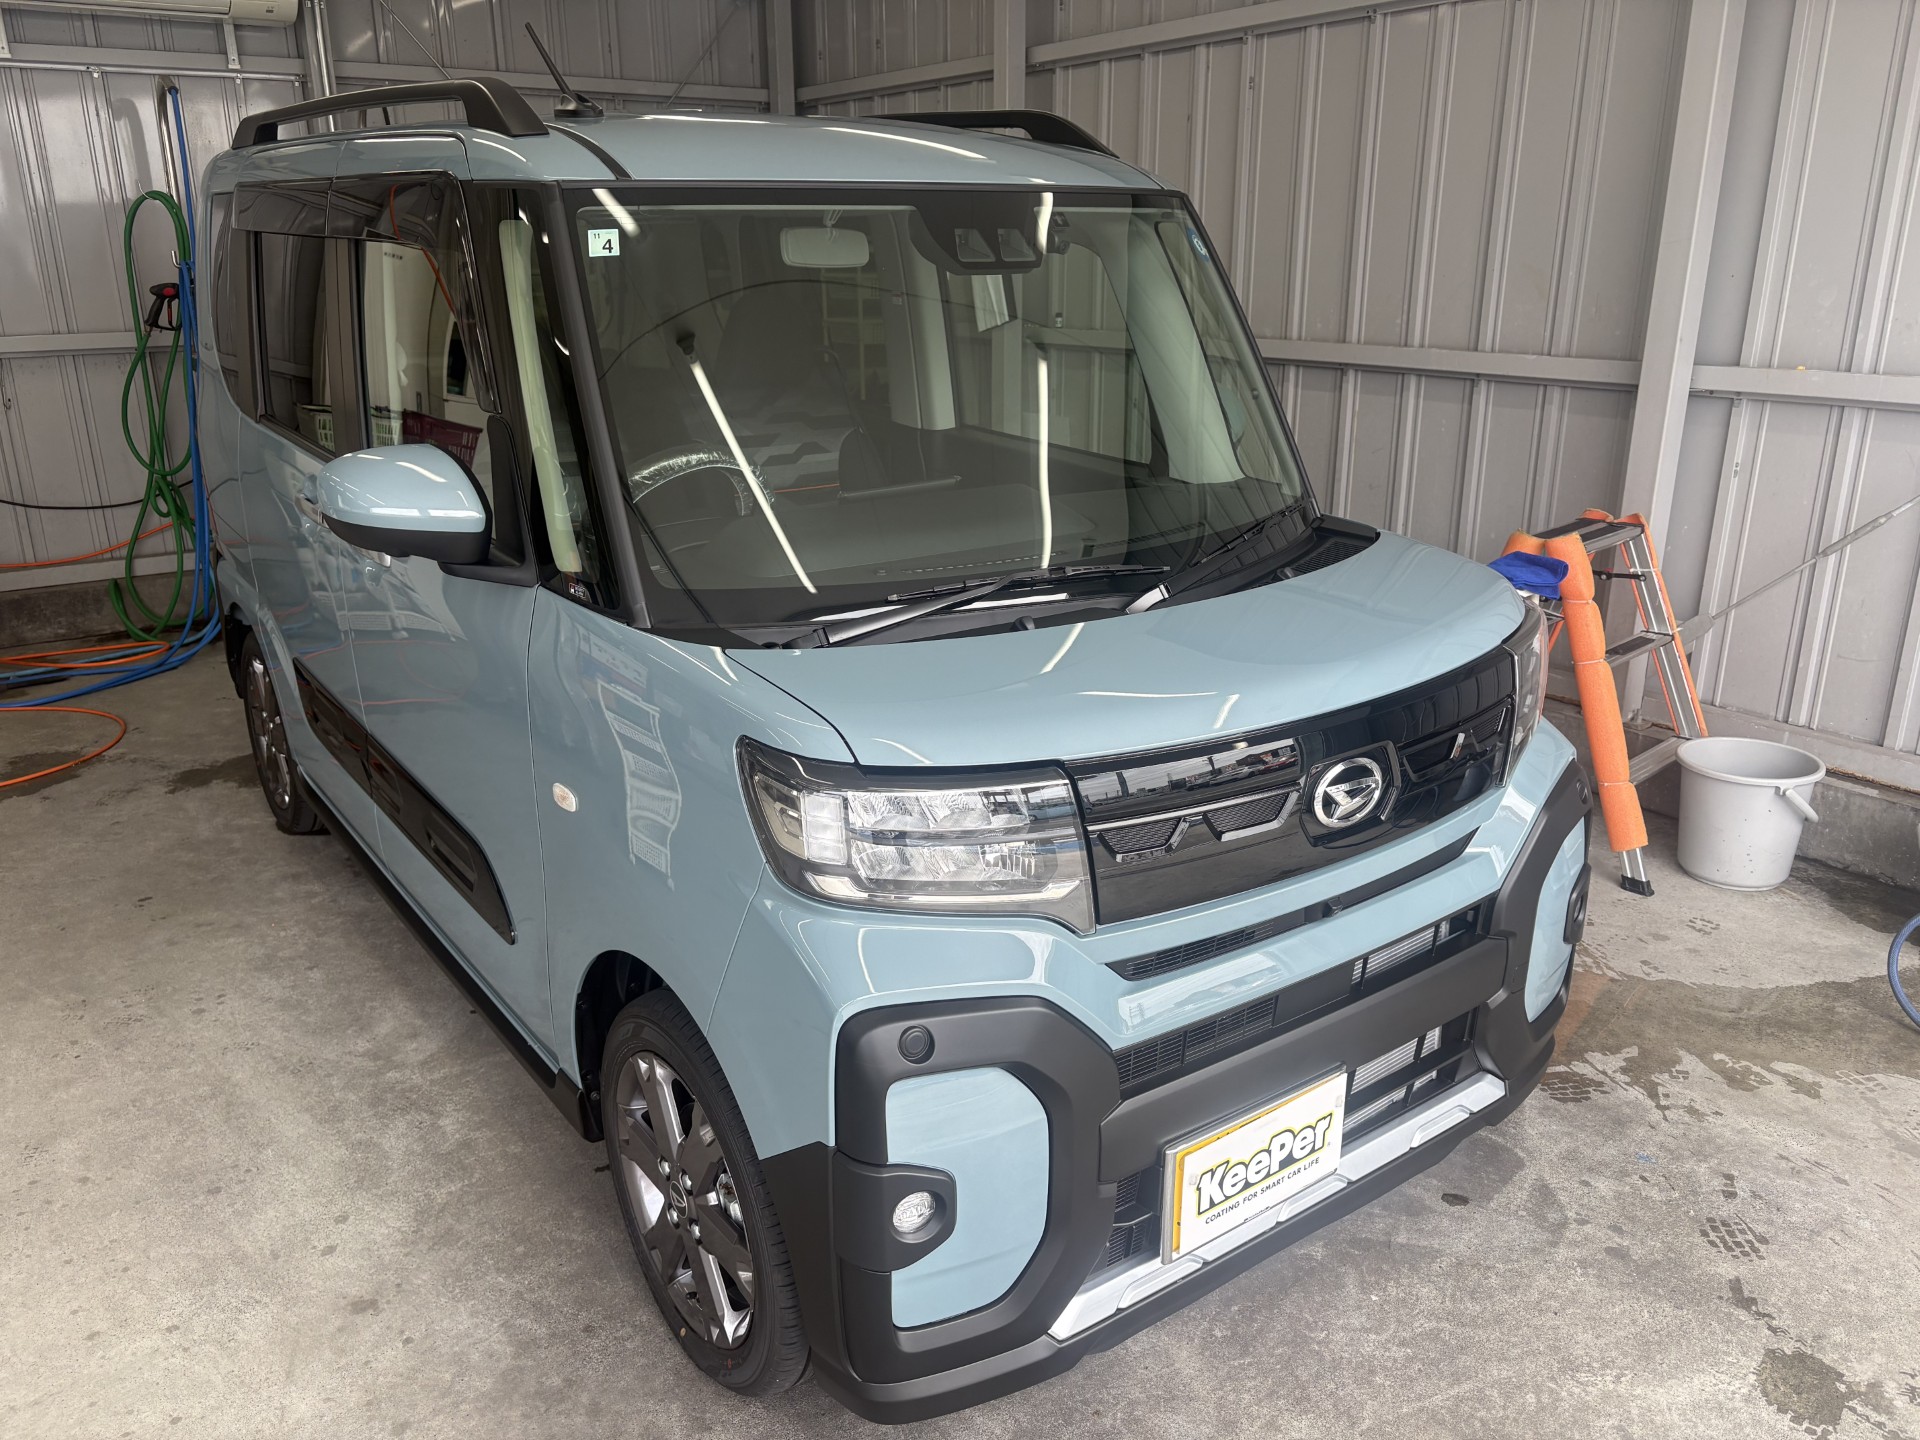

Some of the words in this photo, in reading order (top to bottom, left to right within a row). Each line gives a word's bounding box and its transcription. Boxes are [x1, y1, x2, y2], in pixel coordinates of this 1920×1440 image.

[602, 239, 613, 253] 4
[1197, 1112, 1332, 1215] KeePer
[1205, 1201, 1240, 1224] COATING
[1243, 1191, 1258, 1204] FOR
[1260, 1176, 1285, 1195] SMART
[1287, 1167, 1302, 1180] CAR
[1304, 1157, 1320, 1171] LIFE
